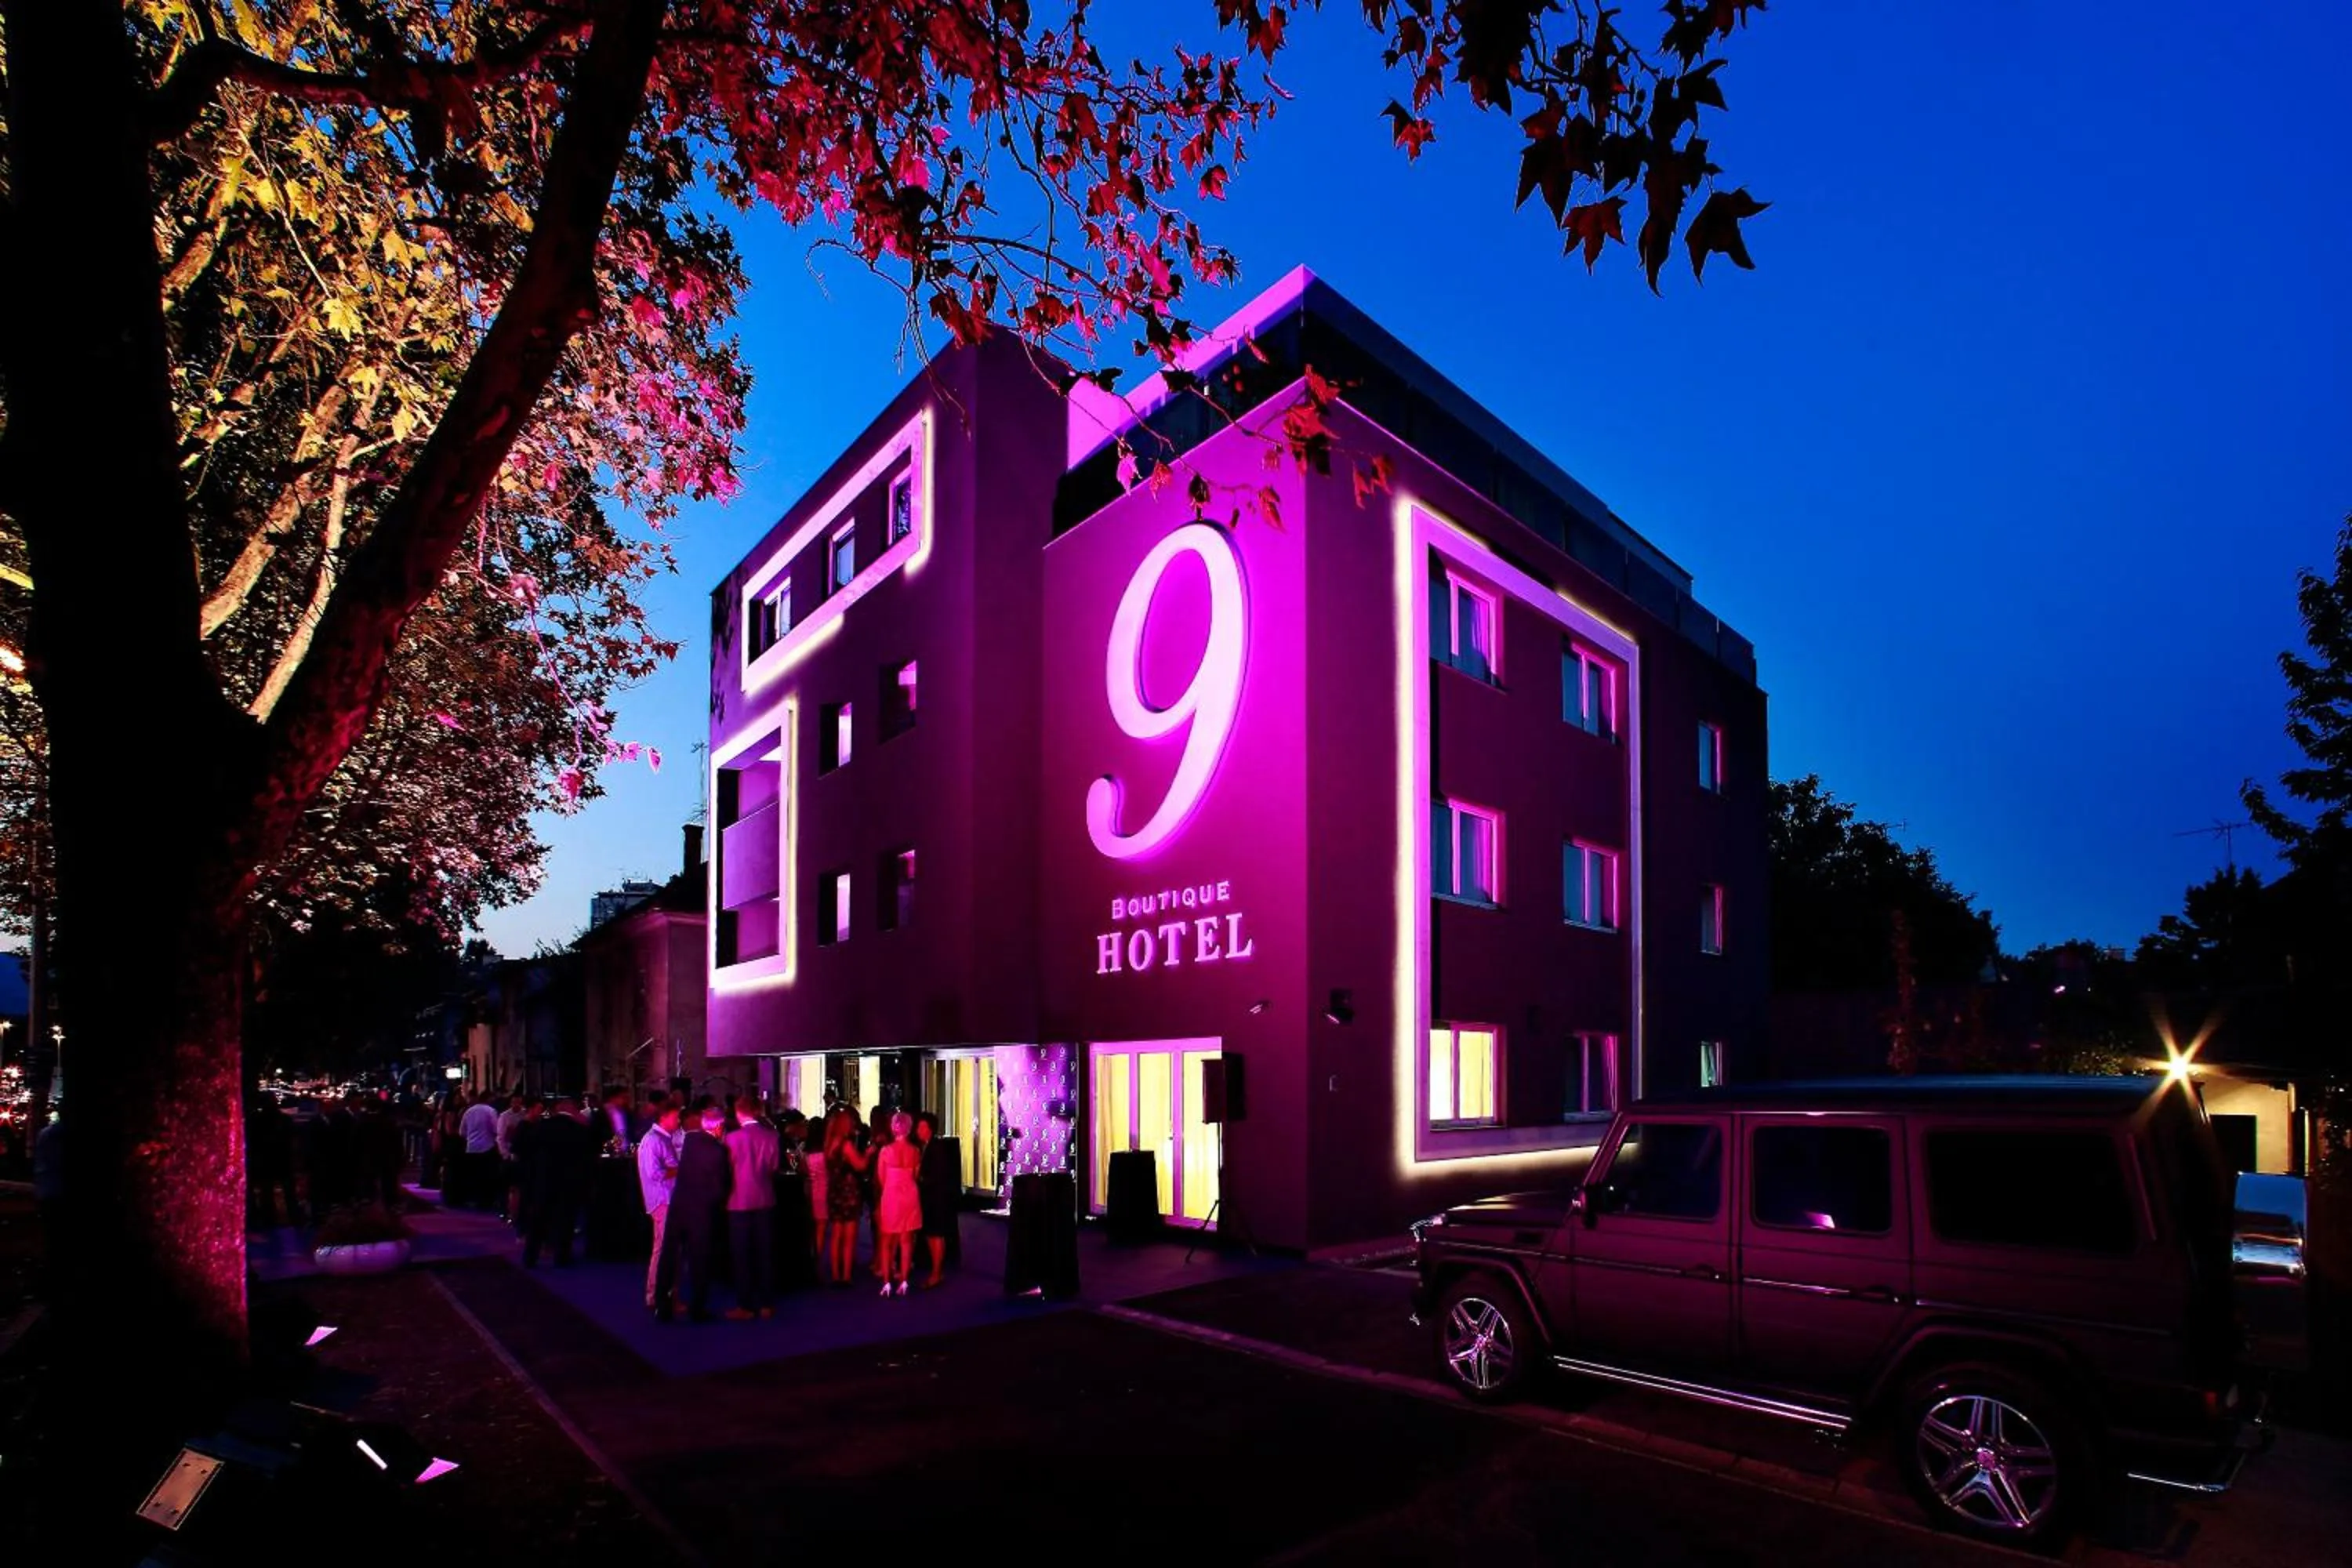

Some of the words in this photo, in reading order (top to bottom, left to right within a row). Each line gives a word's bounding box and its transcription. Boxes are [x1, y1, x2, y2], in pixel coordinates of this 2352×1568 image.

[1086, 521, 1247, 859] 9
[1111, 880, 1230, 920] BOUTIQUE
[1096, 913, 1253, 974] HOTEL
